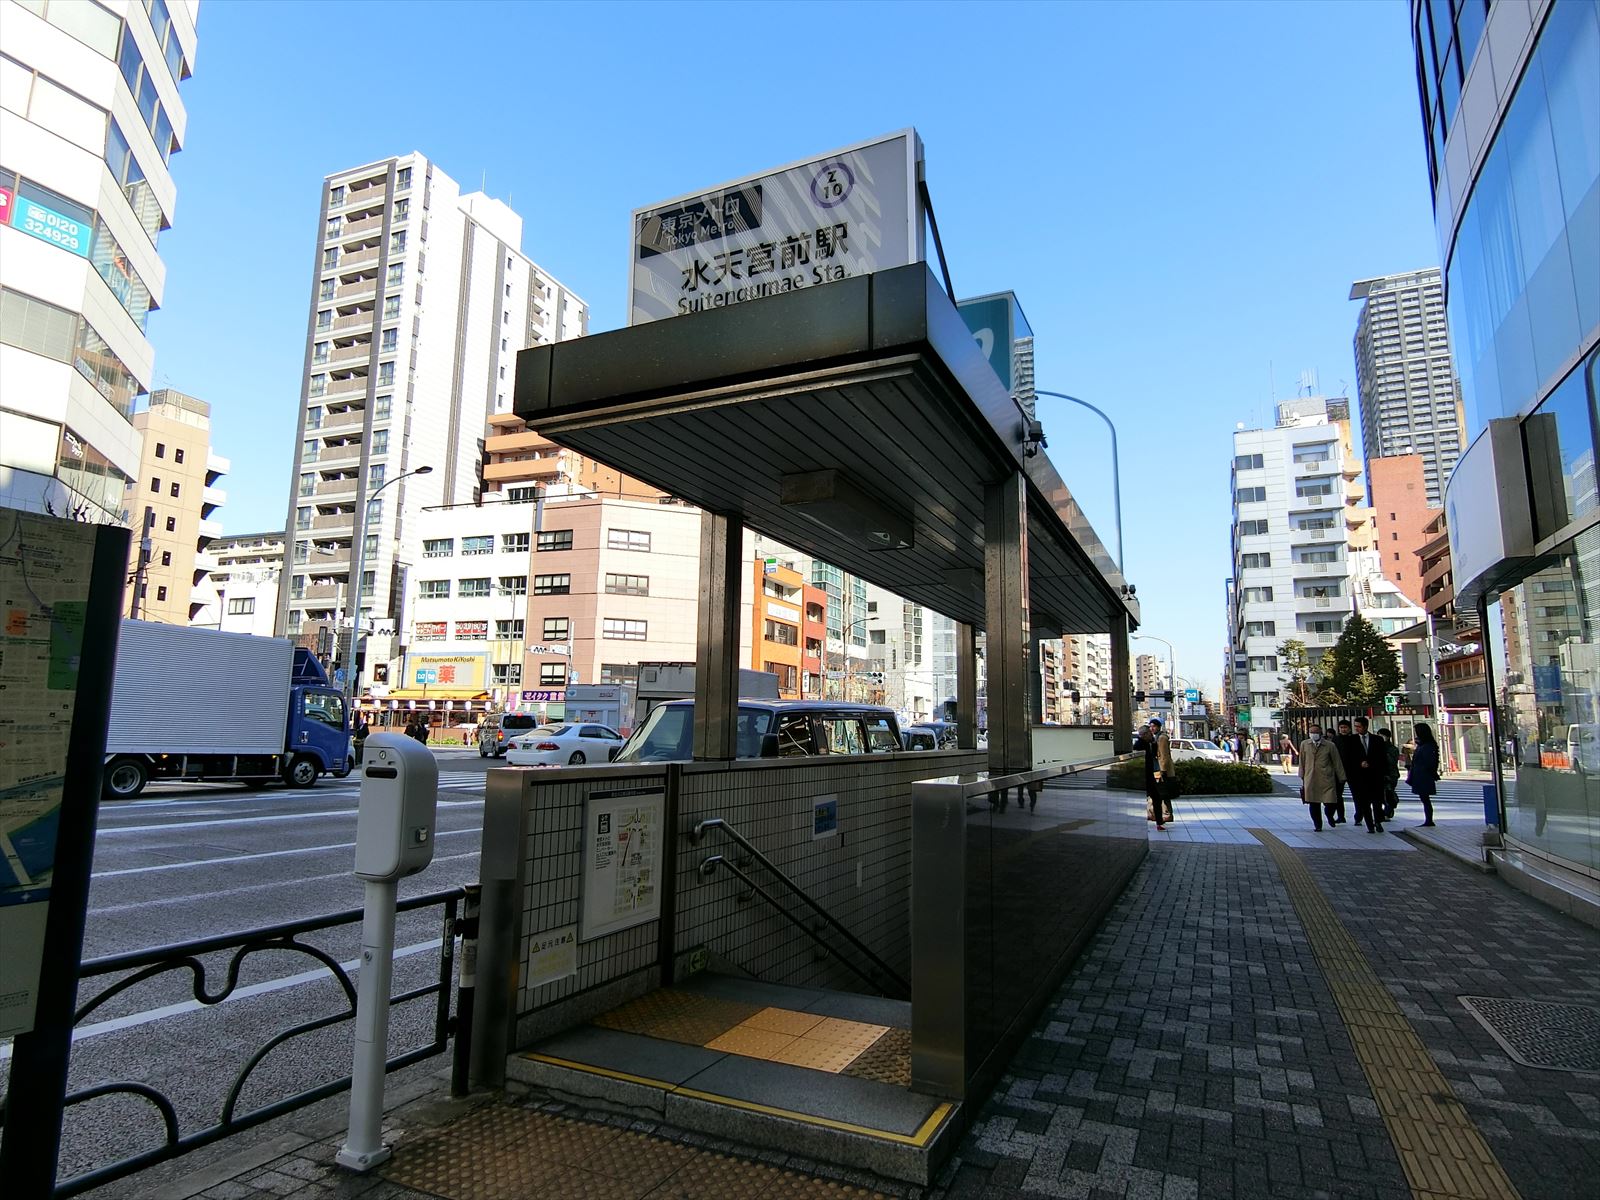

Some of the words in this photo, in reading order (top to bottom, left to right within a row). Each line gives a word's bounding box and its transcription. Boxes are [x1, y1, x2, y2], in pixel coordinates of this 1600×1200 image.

[827, 170, 837, 184] Z
[823, 183, 843, 200] 10
[47, 214, 79, 236] 0120
[661, 197, 740, 232] 東京メトロ
[24, 219, 79, 250] 324929
[665, 228, 698, 246] Tokyo
[699, 219, 734, 239] Metro
[681, 222, 849, 293] 水天宮前駅
[438, 665, 456, 684] 薬
